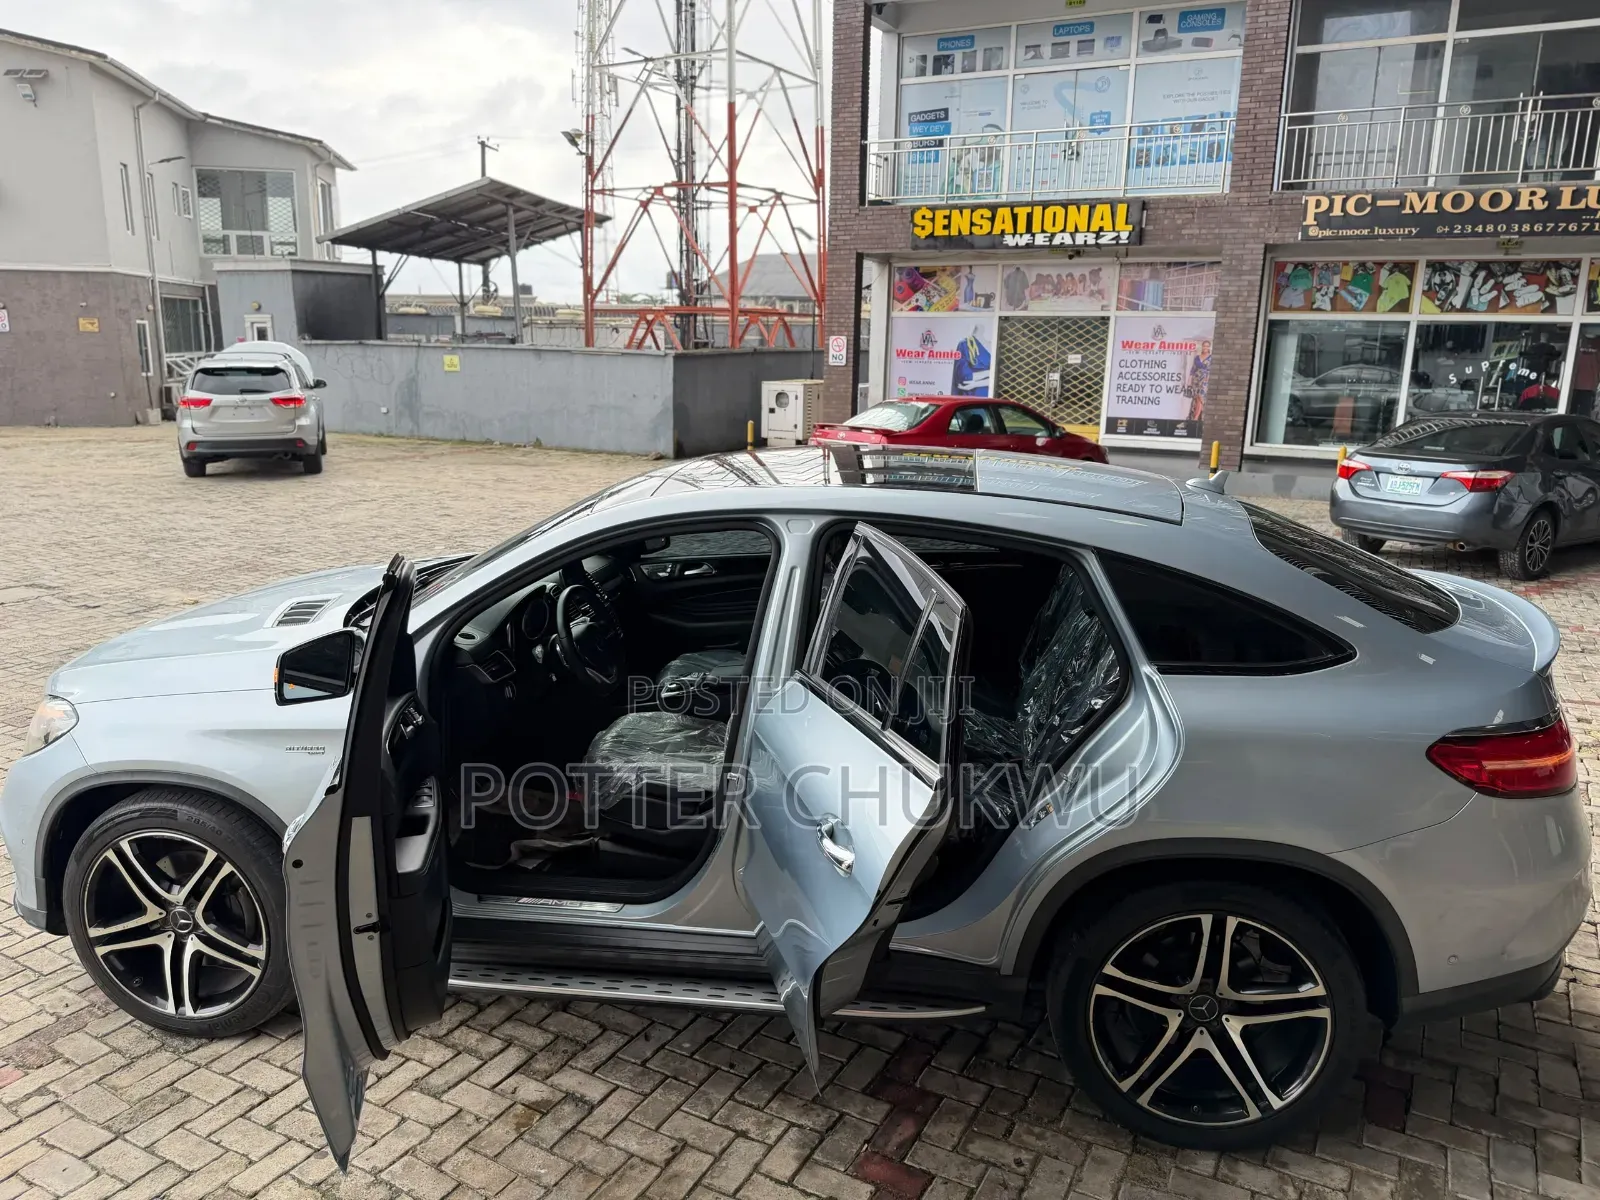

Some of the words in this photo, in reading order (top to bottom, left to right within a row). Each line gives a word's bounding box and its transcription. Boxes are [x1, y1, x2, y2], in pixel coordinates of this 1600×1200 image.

[1187, 13, 1217, 22] GAMING
[1181, 19, 1222, 28] CONSOLES
[1054, 25, 1090, 35] LAPTOPS
[940, 39, 971, 49] PHONES
[910, 111, 945, 122] GADGETS
[912, 125, 928, 133] WEY
[930, 124, 945, 132] DEY
[913, 139, 939, 148] BURST
[1302, 187, 1549, 226] PIC-MOOR
[1121, 340, 1156, 350] Wear
[1158, 341, 1197, 351] Annie
[832, 353, 844, 361] NO
[896, 348, 925, 359] Wear
[928, 349, 962, 360] Annie
[1118, 359, 1167, 369] CLOTHING
[1117, 371, 1182, 382] ACCESSORIES
[1449, 360, 1538, 385] Supreme
[1116, 383, 1146, 393] READY
[1149, 384, 1162, 394] TO
[1166, 385, 1193, 395] WEAR
[1116, 395, 1160, 406] TRAINING
